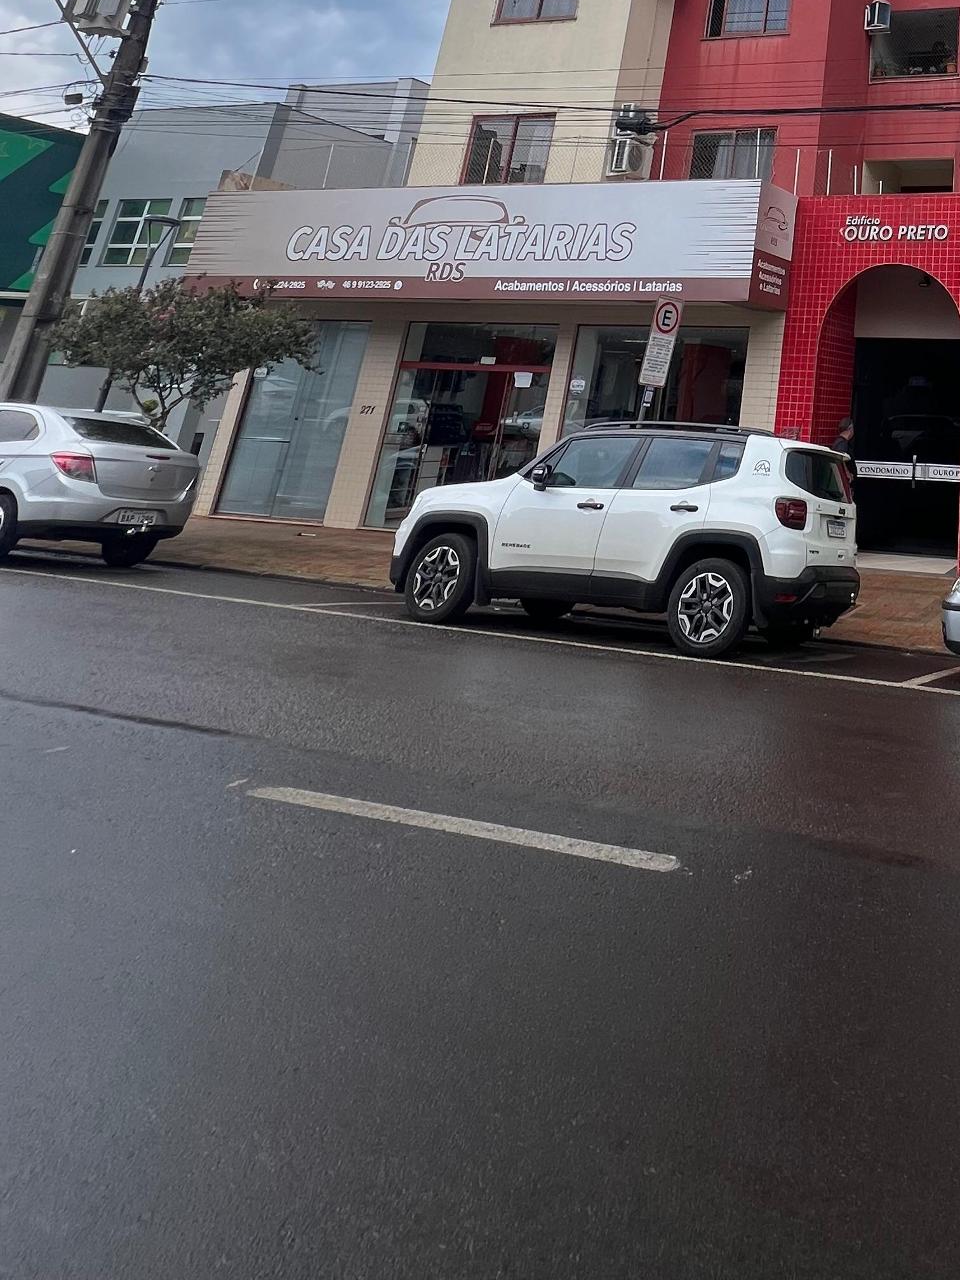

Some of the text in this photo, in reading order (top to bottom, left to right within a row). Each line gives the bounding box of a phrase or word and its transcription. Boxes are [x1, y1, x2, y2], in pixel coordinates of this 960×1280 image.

[846, 215, 880, 225] Edifício
[845, 224, 948, 240] OURO PRETO
[286, 222, 636, 261] CASA DAS LATARIAS
[426, 262, 466, 281] RDS
[494, 280, 564, 292] Acabamentos
[572, 280, 631, 292] Acessórios
[639, 280, 682, 292] Latarias
[661, 309, 673, 327] E
[360, 405, 377, 416] 271
[932, 468, 955, 477] OURO
